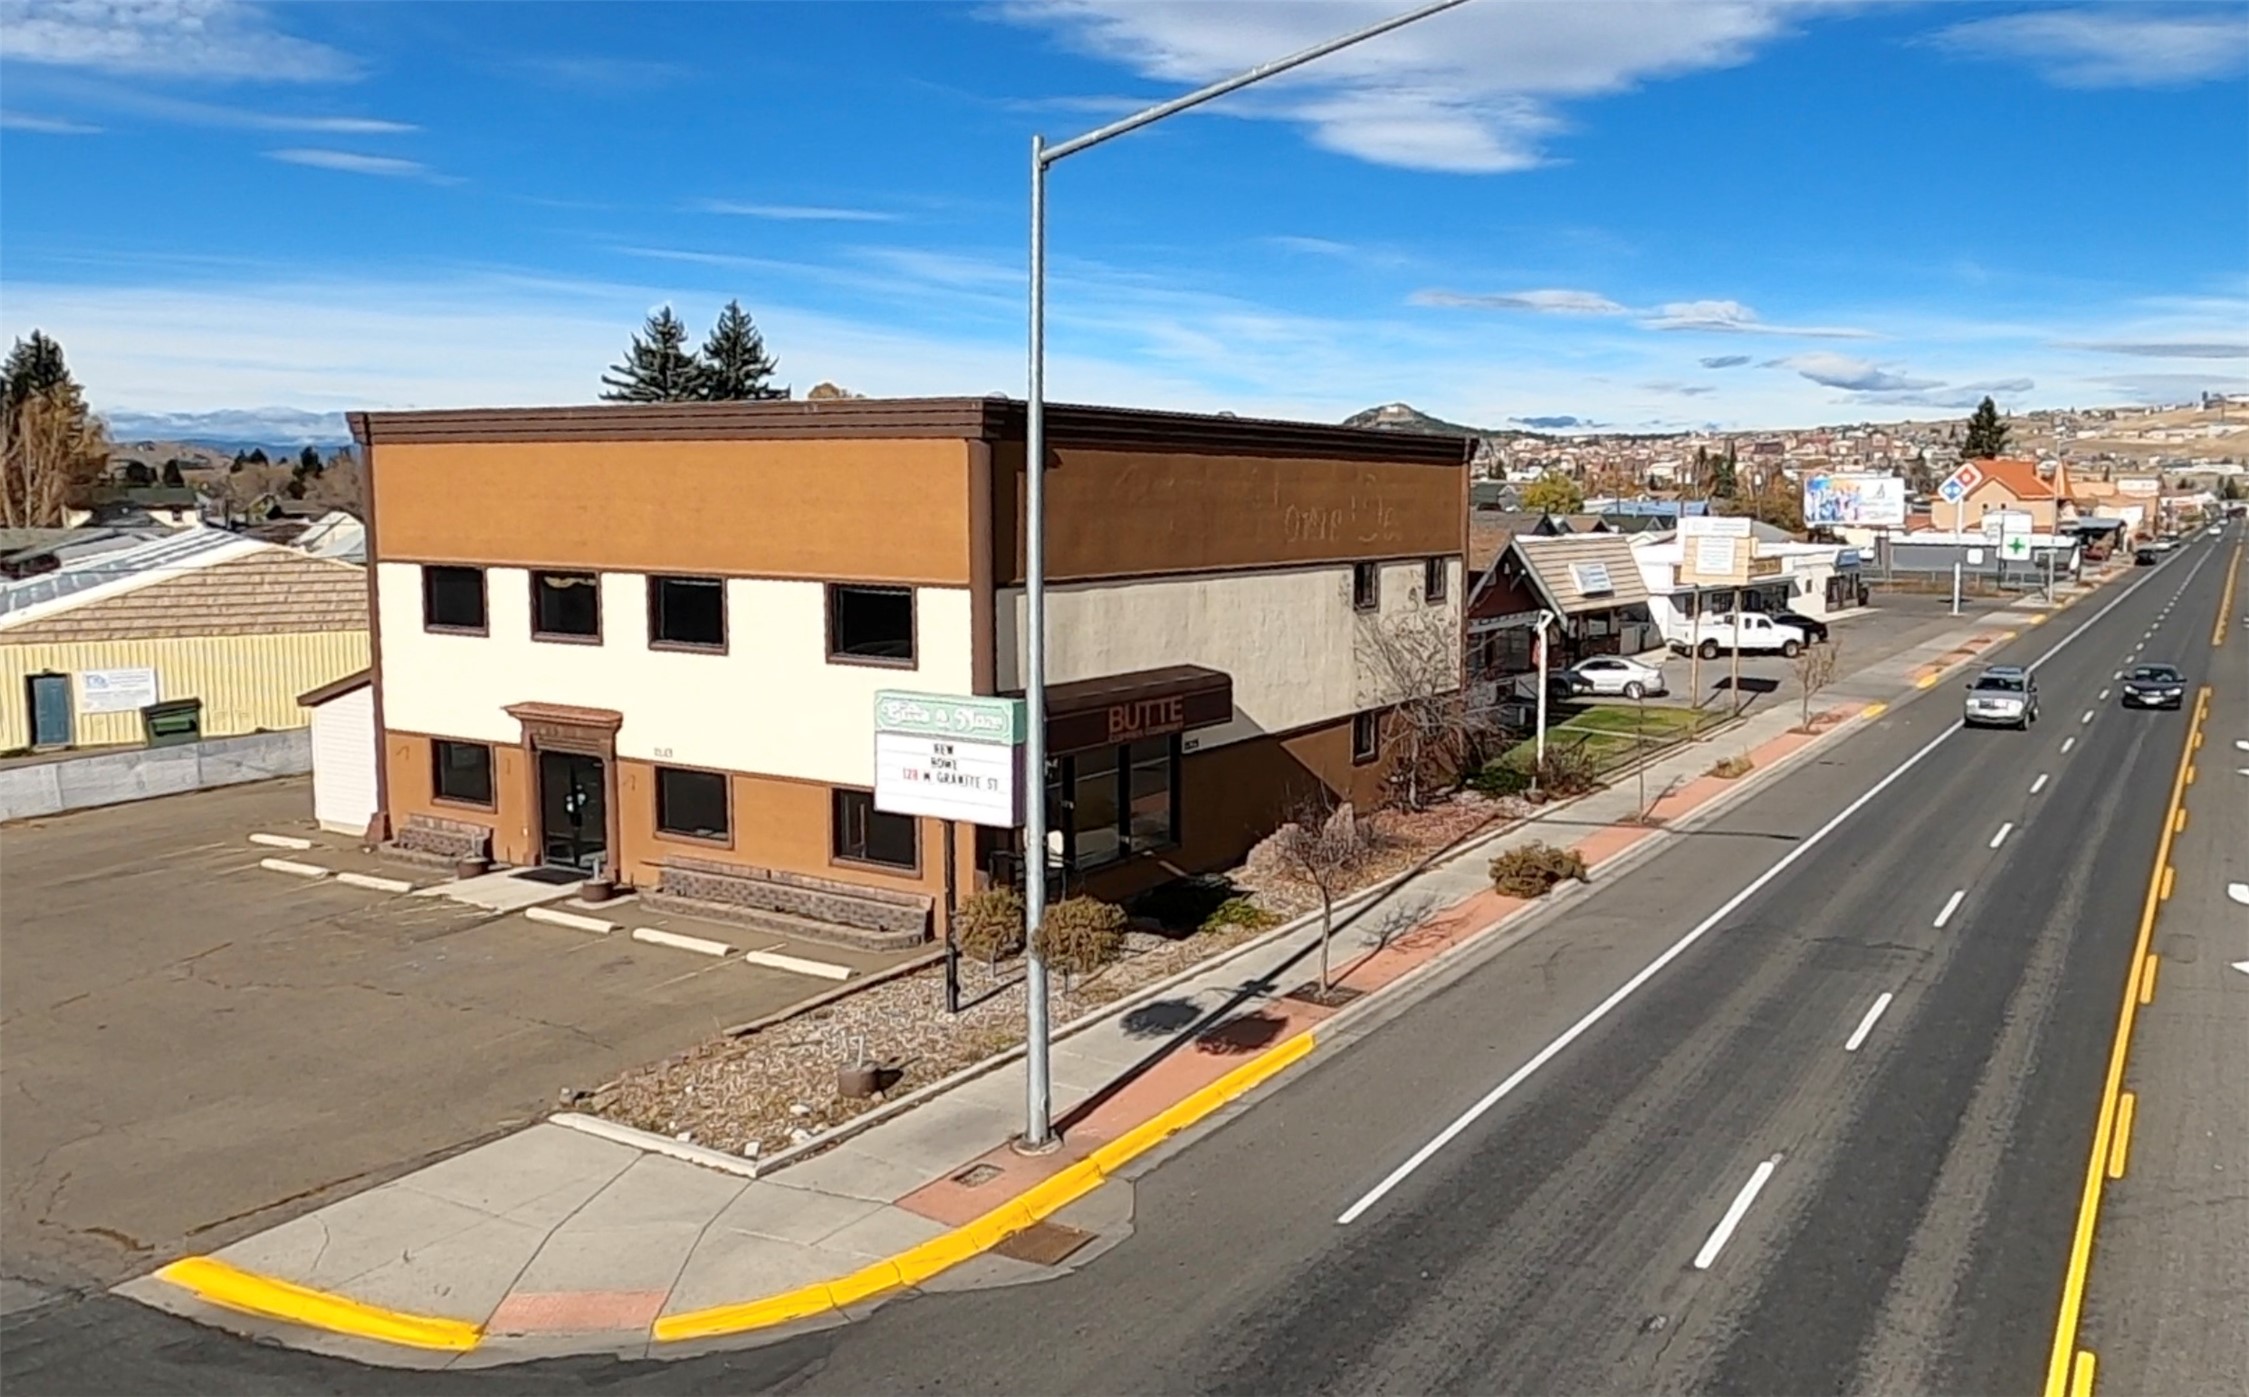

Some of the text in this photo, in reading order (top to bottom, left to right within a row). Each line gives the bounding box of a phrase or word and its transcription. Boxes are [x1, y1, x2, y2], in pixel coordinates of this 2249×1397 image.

[1109, 695, 1183, 732] BUTTE
[934, 743, 954, 755] NEW
[931, 757, 957, 770] HOME
[937, 771, 981, 789] GRANITE
[987, 777, 998, 791] ST
